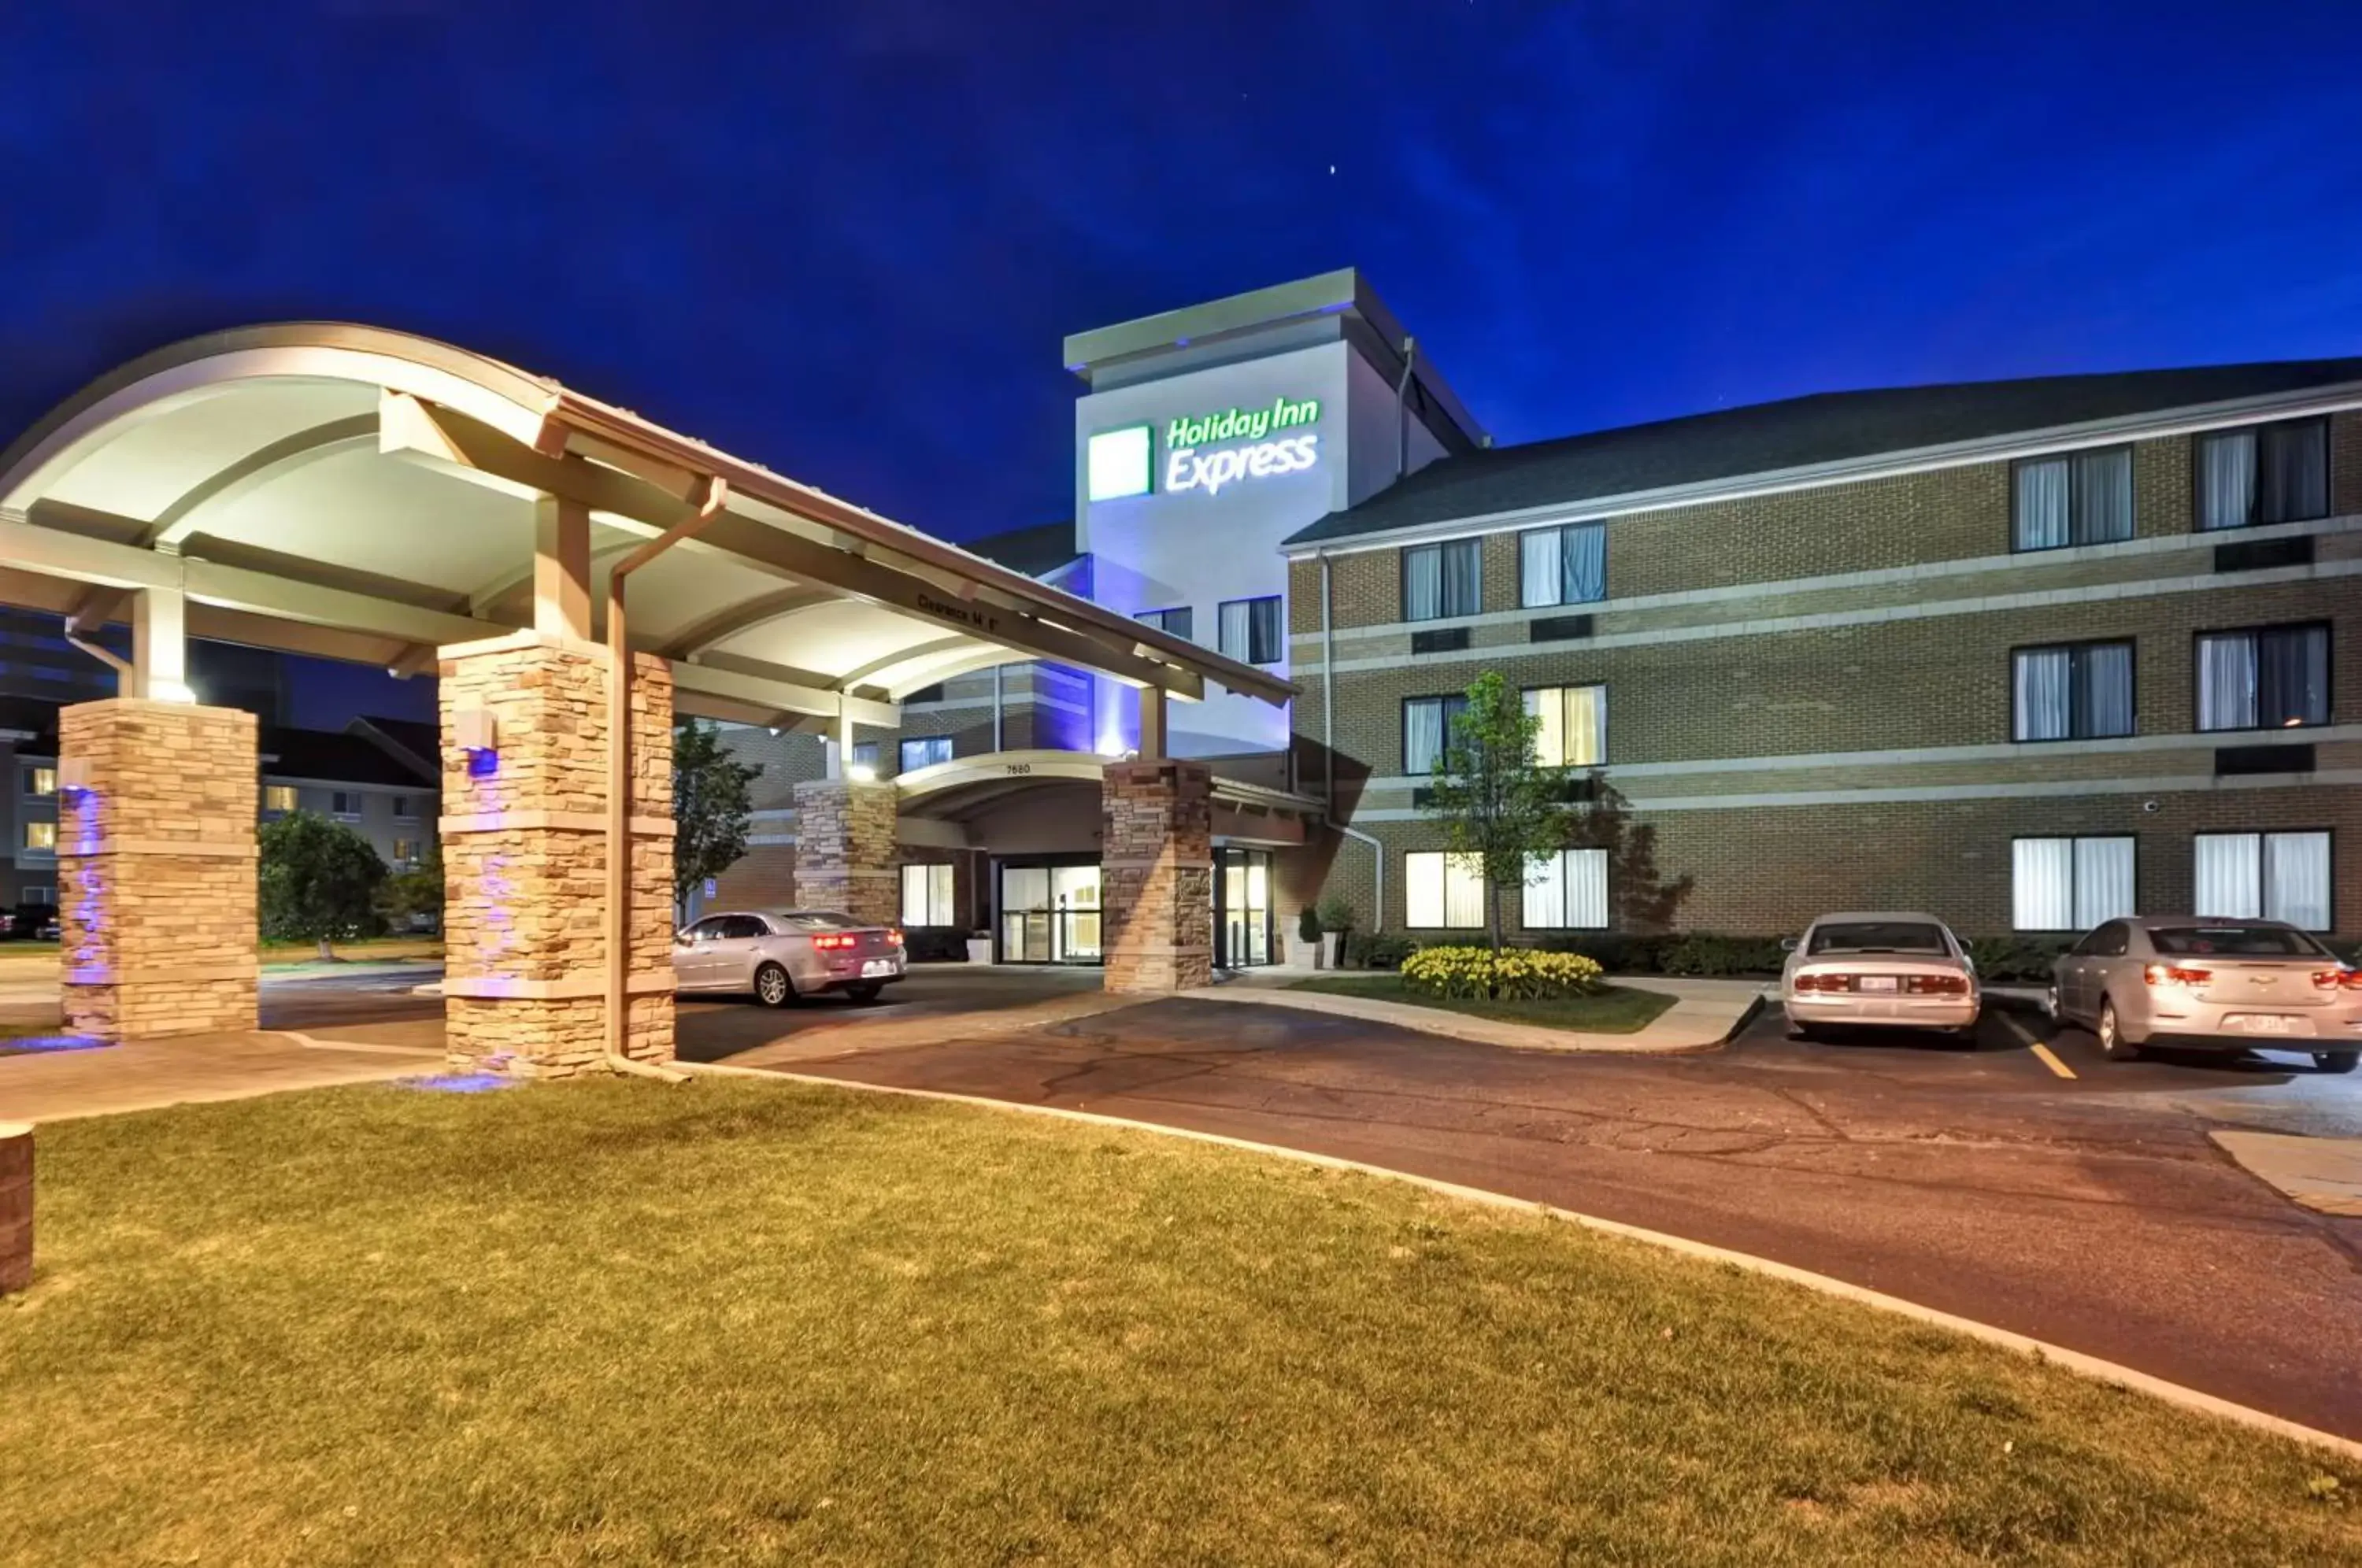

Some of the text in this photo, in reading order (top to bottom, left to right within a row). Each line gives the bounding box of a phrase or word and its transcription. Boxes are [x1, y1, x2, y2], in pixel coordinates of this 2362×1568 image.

[1167, 398, 1319, 449] Holiday Inn
[1165, 435, 1319, 496] Express
